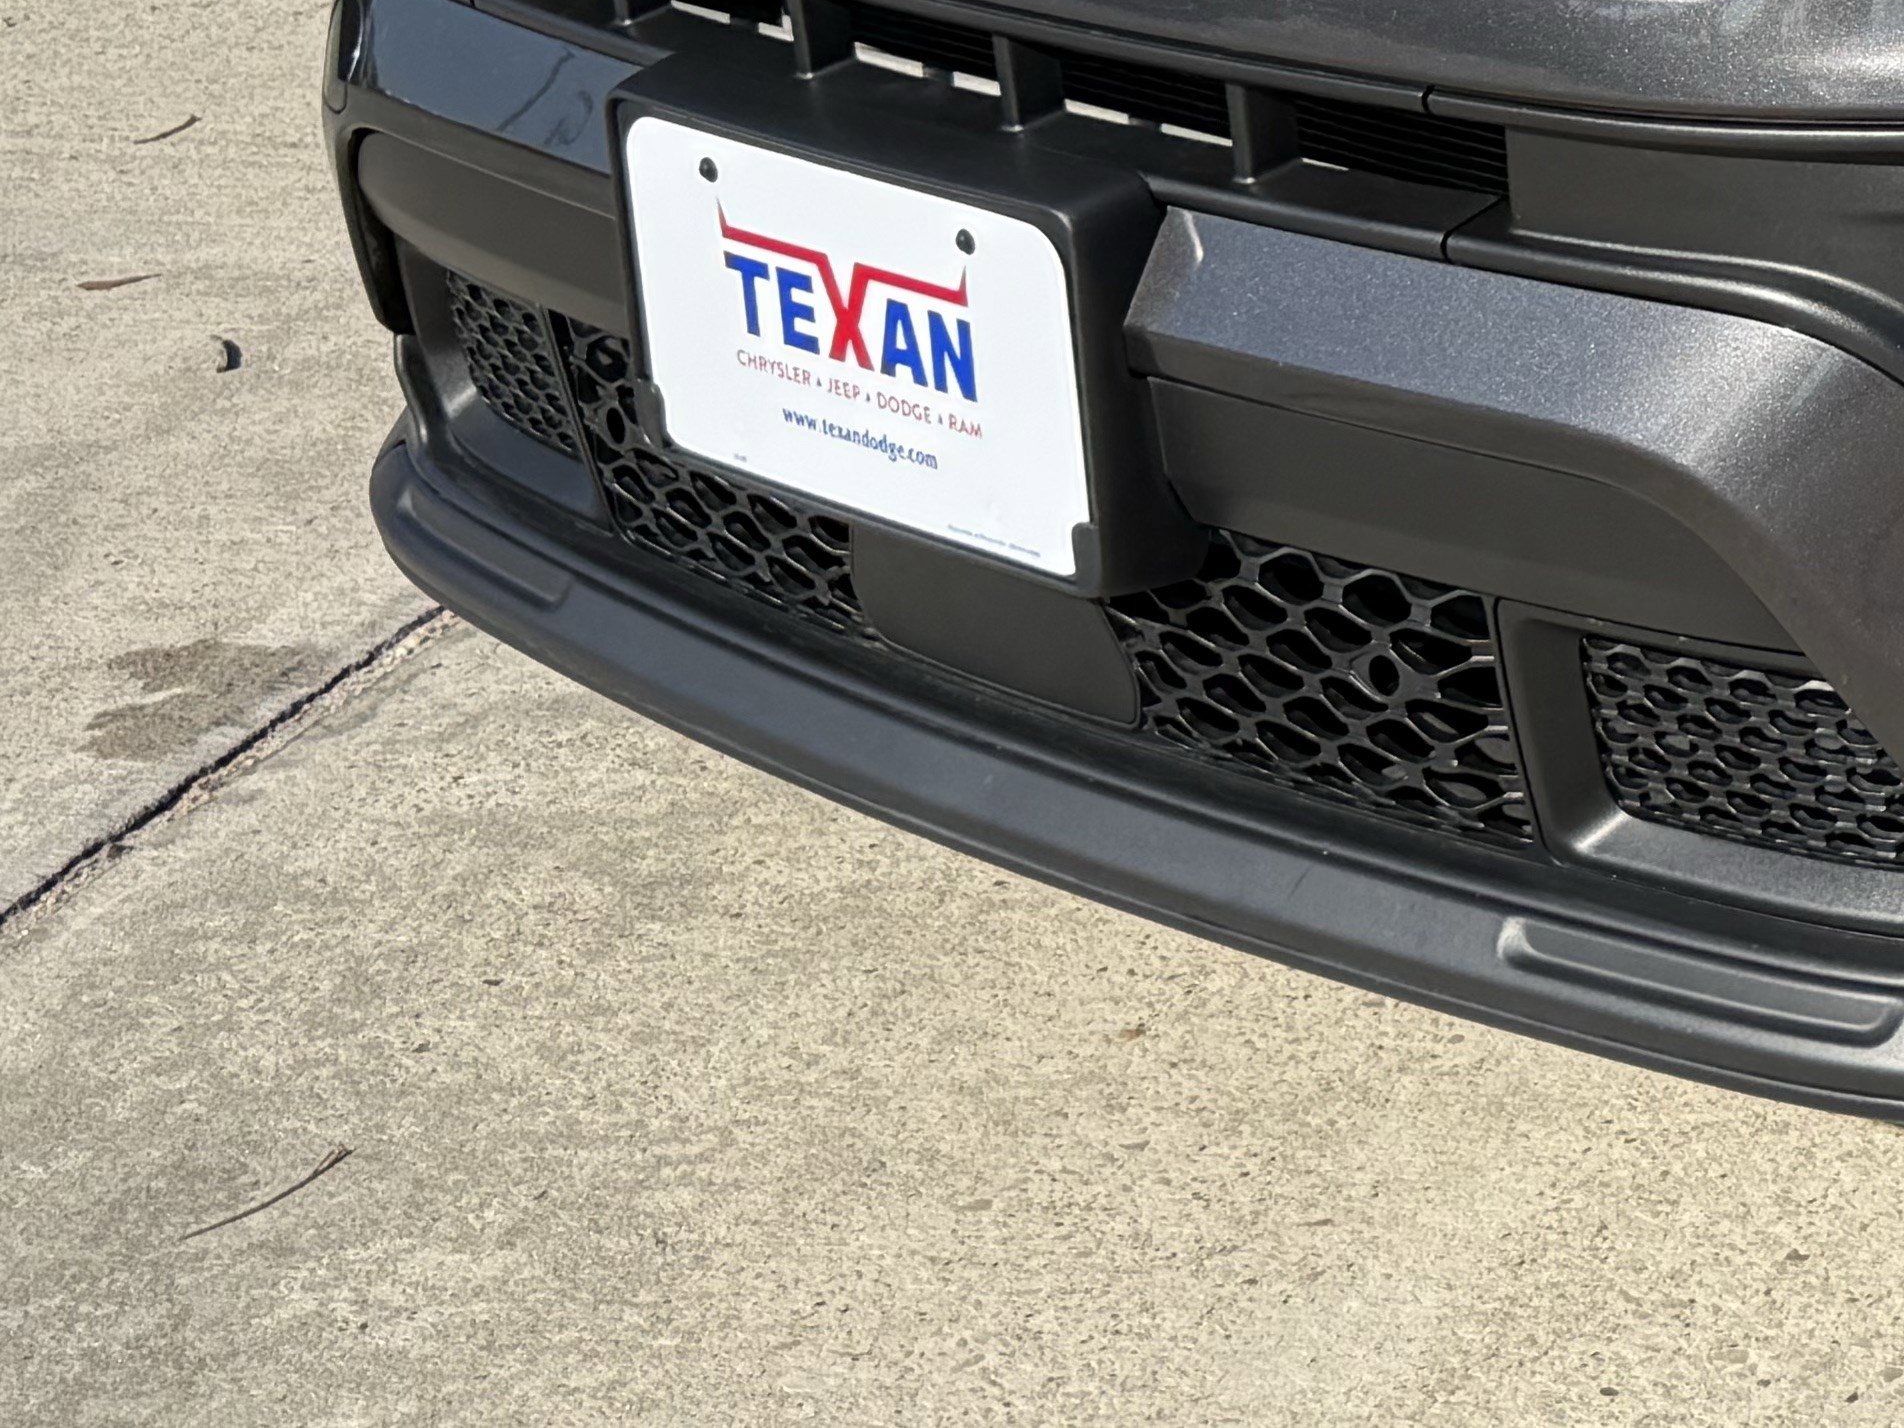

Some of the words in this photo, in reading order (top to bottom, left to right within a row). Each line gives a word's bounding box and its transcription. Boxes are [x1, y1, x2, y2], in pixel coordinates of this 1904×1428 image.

[716, 197, 978, 402] TEXAN
[737, 349, 811, 386] CHRYSLER
[827, 378, 861, 404] JEEP
[876, 391, 932, 425] DODGE
[948, 413, 983, 439] RAM
[782, 408, 938, 470] www.texandodge.com
